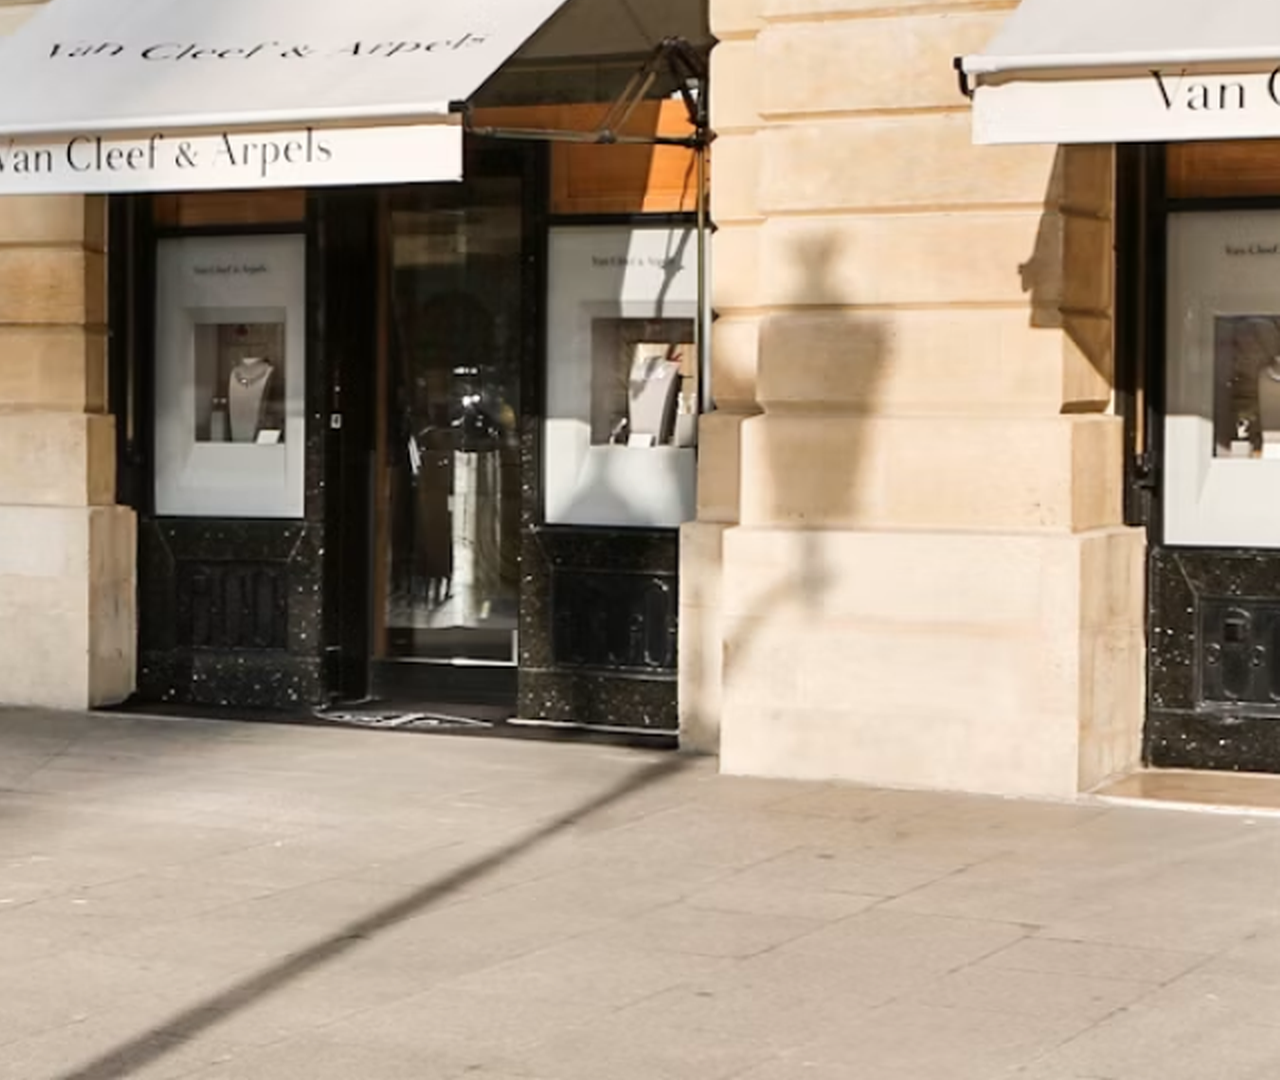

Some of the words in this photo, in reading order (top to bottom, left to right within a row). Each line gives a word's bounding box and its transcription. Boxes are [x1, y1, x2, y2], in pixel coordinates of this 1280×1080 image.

[48, 41, 124, 59] Van
[141, 41, 278, 61] Cleef
[280, 44, 316, 58] &
[334, 32, 486, 57] Arpels
[1148, 68, 1244, 110] Van
[67, 134, 163, 172] Cleef
[174, 141, 198, 168] &
[213, 127, 332, 177] Arpels
